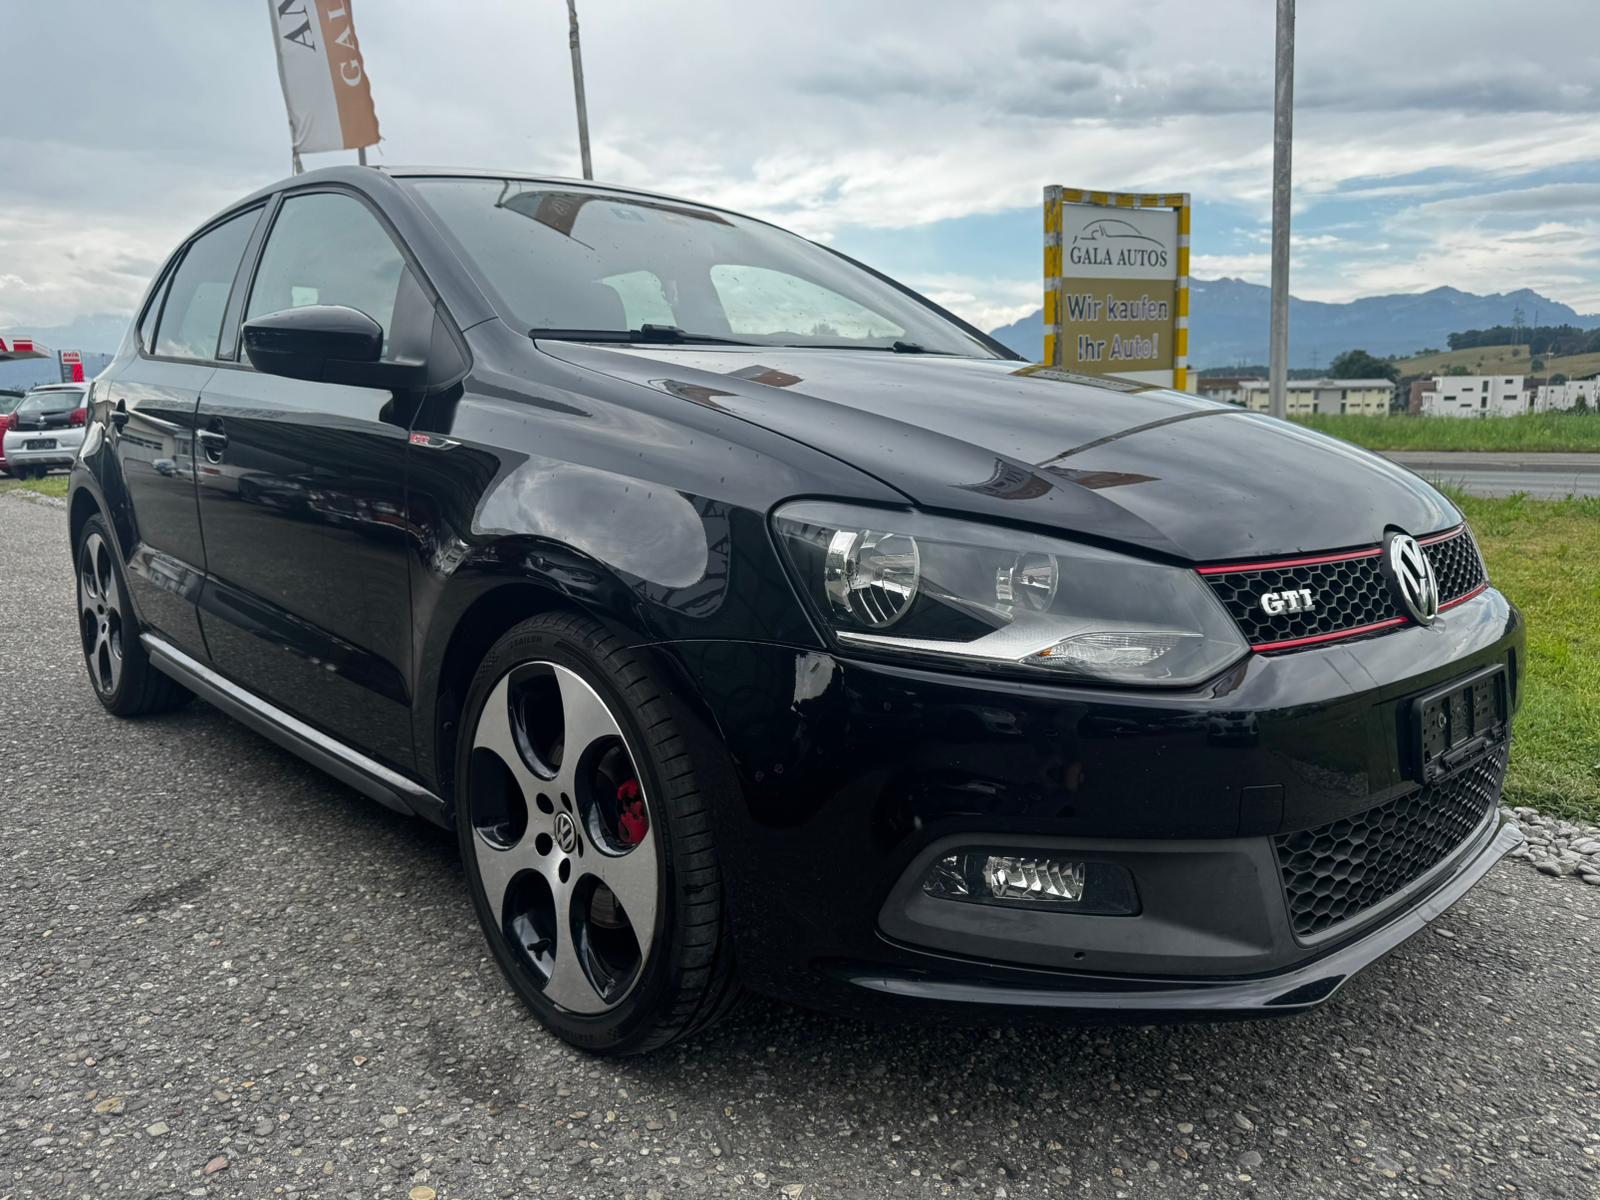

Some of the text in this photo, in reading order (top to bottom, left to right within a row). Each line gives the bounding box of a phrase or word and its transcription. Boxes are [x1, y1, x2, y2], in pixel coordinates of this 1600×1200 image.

[1070, 246, 1168, 267] GALA AUTOS
[1066, 294, 1168, 322] Wir kaufen
[1077, 332, 1159, 362] Ihr Auto!
[1260, 588, 1316, 616] GTI
